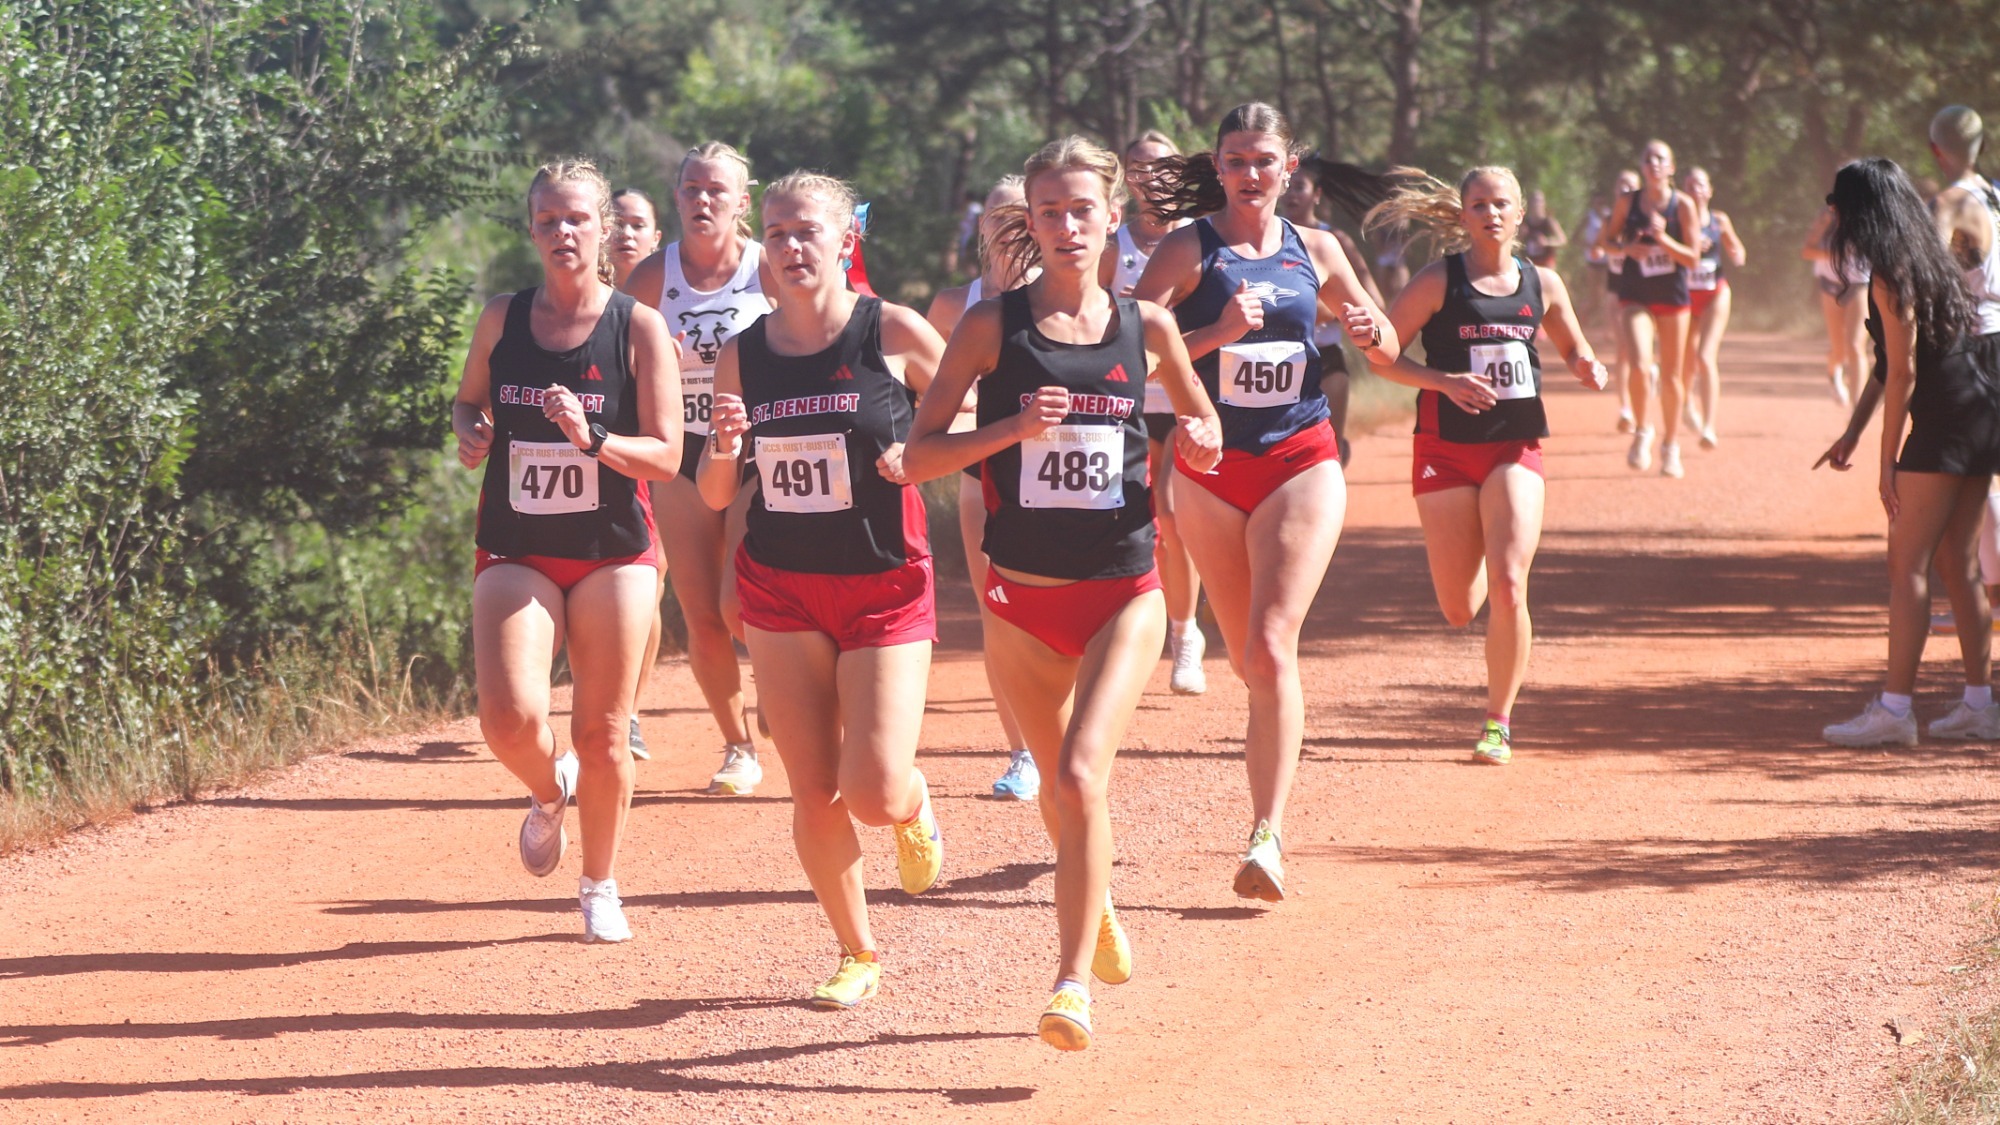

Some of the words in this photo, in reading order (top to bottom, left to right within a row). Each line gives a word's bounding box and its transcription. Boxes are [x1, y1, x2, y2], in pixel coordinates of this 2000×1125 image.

[1459, 325, 1479, 339] ST.
[1480, 324, 1535, 340] BENEDICT
[1234, 361, 1294, 394] 450
[1484, 360, 1526, 388] 490
[500, 384, 519, 404] ST.
[752, 403, 771, 425] ST.
[773, 393, 860, 419] BENEDICT
[1068, 394, 1135, 418] NEDICT
[783, 440, 838, 452] RUST-BUSTER
[521, 465, 583, 499] 470
[772, 458, 830, 497] 491
[1038, 451, 1109, 491] 483
